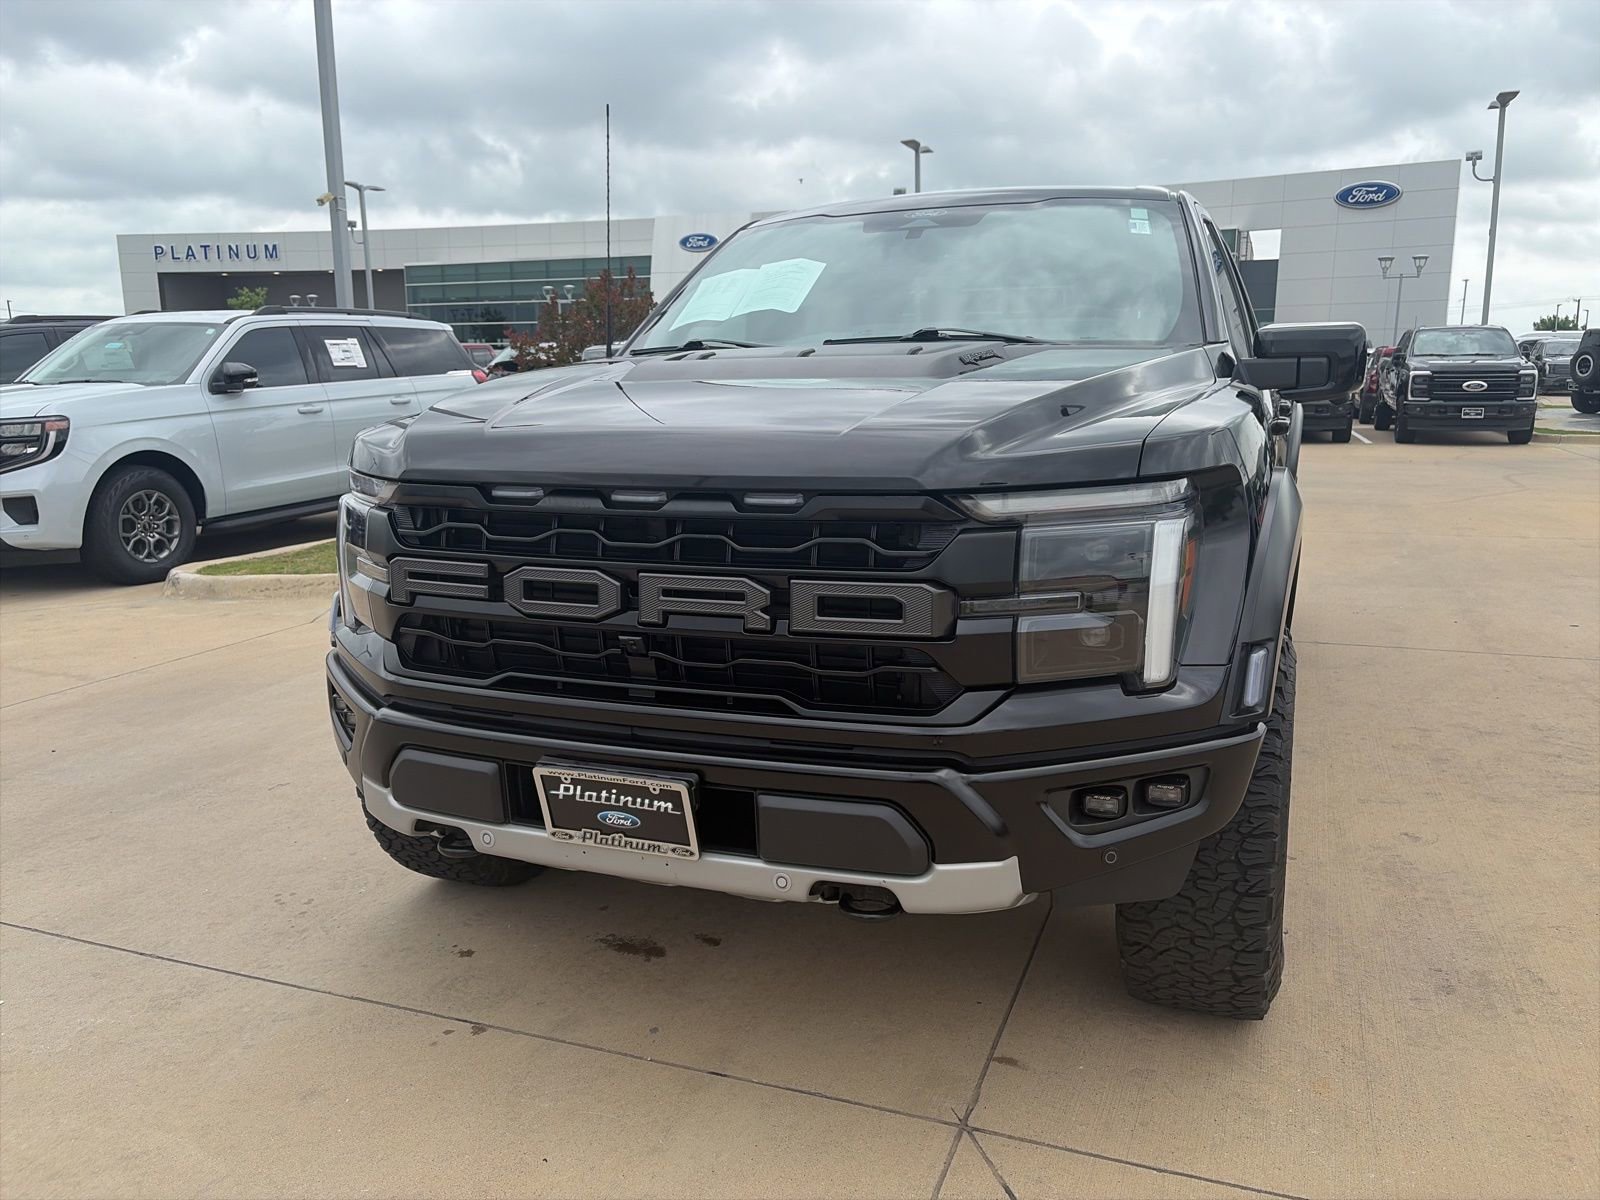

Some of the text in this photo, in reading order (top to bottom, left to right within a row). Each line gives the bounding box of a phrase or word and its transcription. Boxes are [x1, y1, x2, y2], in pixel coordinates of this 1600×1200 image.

[1347, 187, 1388, 203] Ford
[153, 243, 280, 261] PLATINUM
[388, 555, 954, 641] FORD
[549, 783, 682, 815] Platinum
[605, 813, 633, 826] Ford
[581, 830, 668, 854] Platinum
